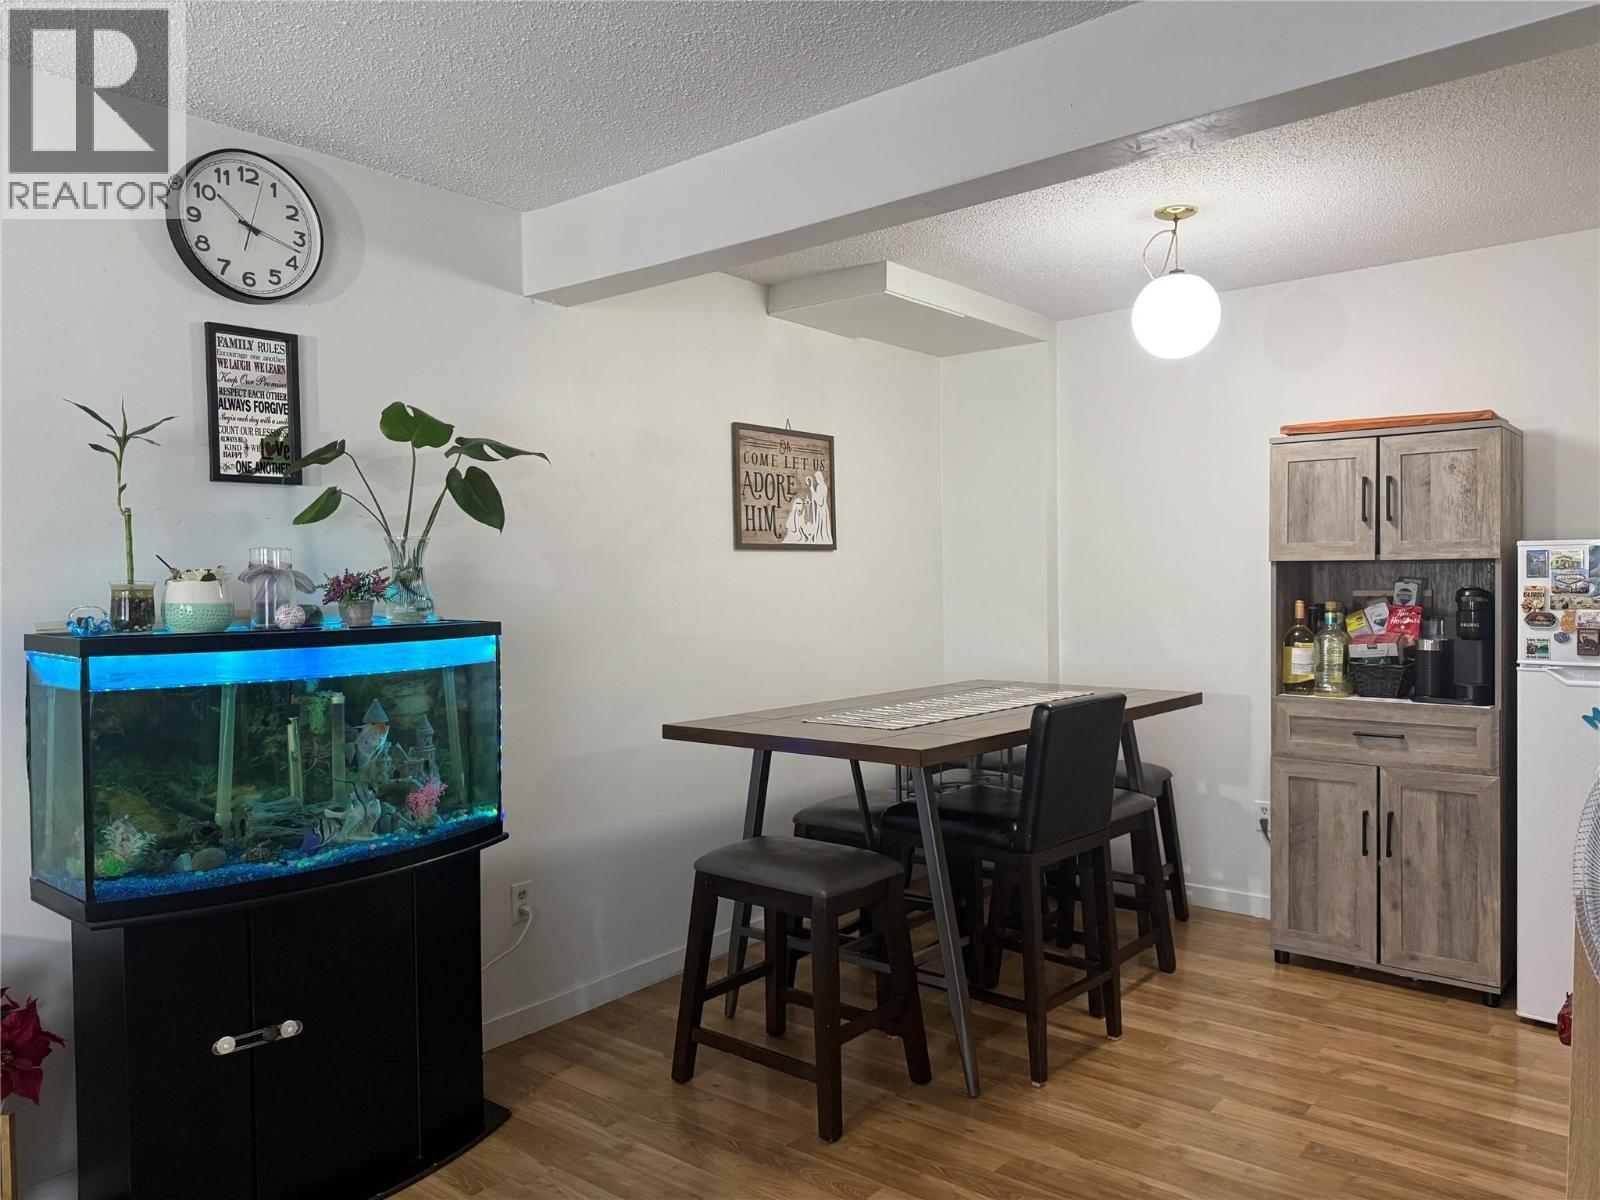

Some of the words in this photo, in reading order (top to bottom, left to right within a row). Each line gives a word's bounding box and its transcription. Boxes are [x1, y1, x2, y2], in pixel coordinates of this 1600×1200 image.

[214, 167, 230, 186] 11
[236, 165, 260, 186] 12
[193, 182, 217, 201] 10
[270, 182, 278, 198] 1
[186, 206, 202, 223] 9
[285, 205, 300, 222] 2
[194, 234, 211, 252] 8
[292, 230, 306, 247] 3
[216, 258, 231, 276] 7
[285, 255, 299, 271] 4
[242, 271, 257, 288] 6
[268, 269, 282, 286] 5
[216, 336, 254, 351] FAMILY
[257, 341, 286, 355] RULES
[216, 358, 228, 369] WE
[229, 359, 251, 372] LAUGH
[254, 361, 265, 373] WE
[265, 363, 286, 375] LEARN
[262, 354, 286, 364] another
[217, 371, 238, 387] Keep
[240, 373, 255, 385] Our
[218, 387, 247, 398] RESPECT
[248, 389, 265, 400] EACH
[266, 391, 288, 402] OTHER
[218, 398, 252, 413] ALWAYS
[254, 401, 289, 415] FORGIVE
[249, 416, 260, 426] day
[240, 426, 254, 437] OUR
[222, 451, 243, 459] HAPPY
[224, 444, 242, 452] KIND
[778, 439, 793, 455] Oh
[235, 460, 254, 474] ONE
[743, 450, 779, 467] COME
[784, 455, 809, 470] LET
[812, 458, 826, 472] US
[741, 470, 797, 509] ADORE
